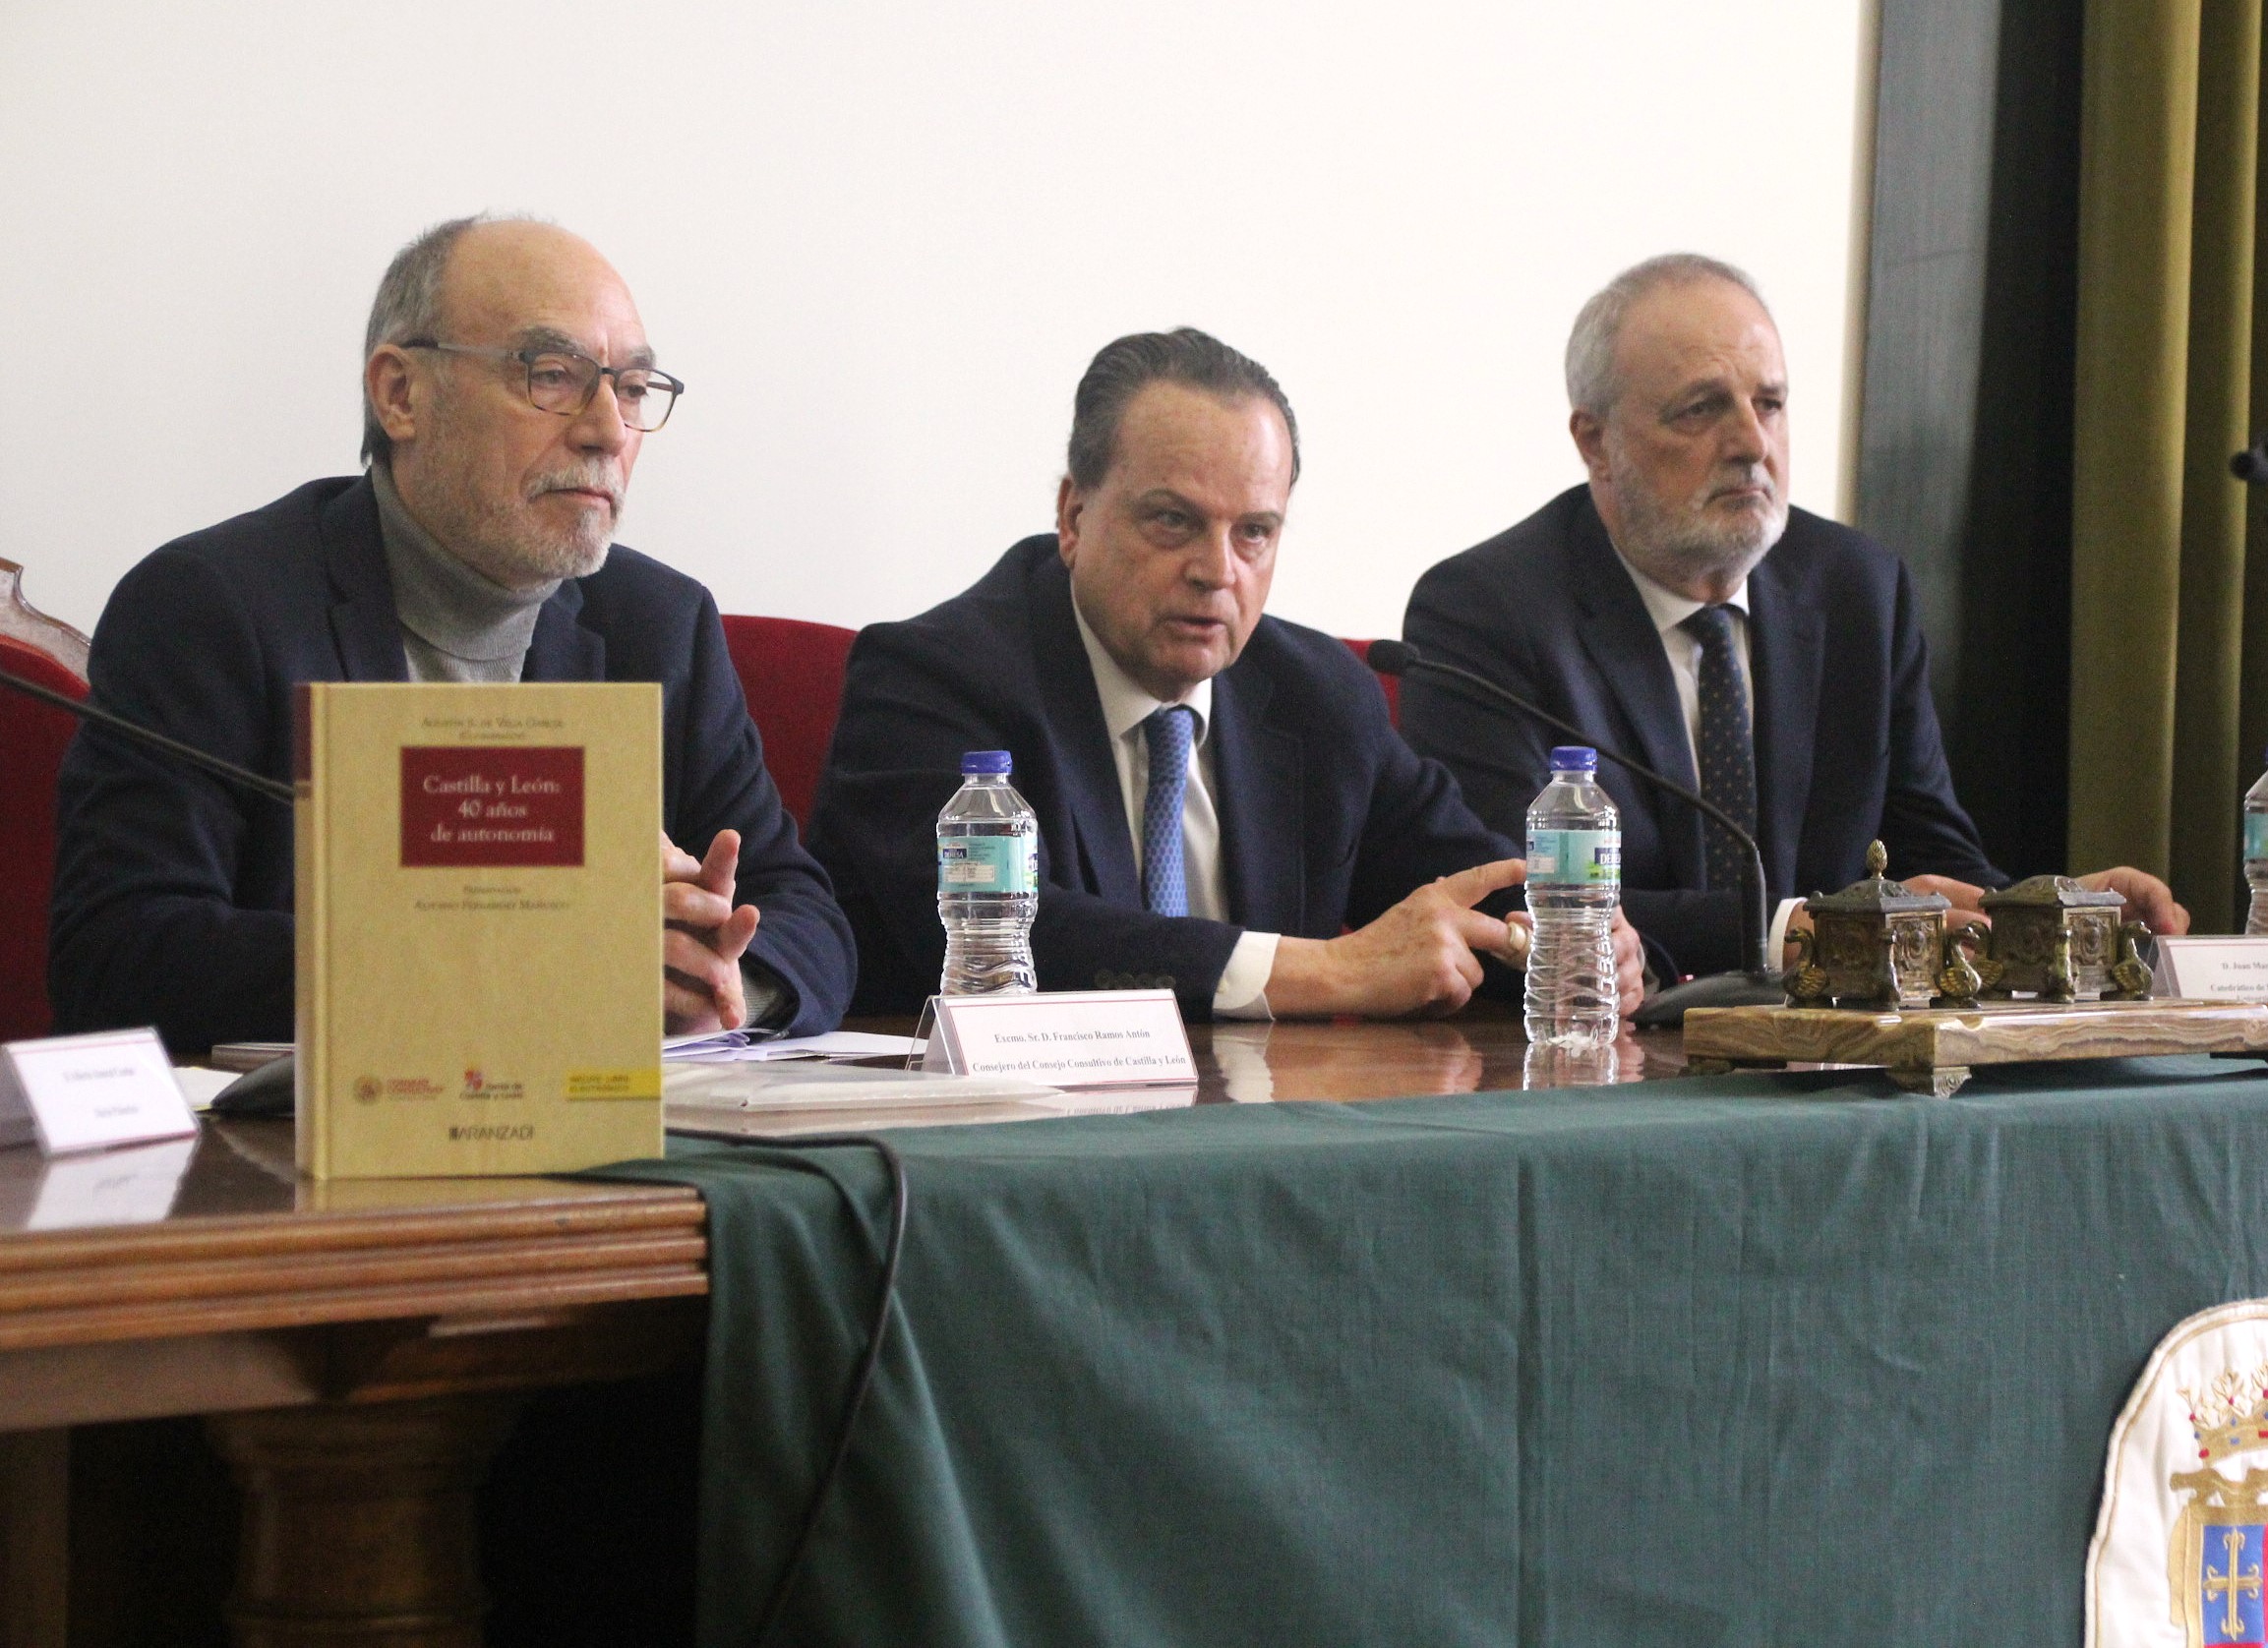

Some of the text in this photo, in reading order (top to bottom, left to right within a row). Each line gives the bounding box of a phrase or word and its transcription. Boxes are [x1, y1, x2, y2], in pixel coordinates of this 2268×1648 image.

[423, 774, 491, 794] Castilla
[495, 781, 506, 796] y
[457, 798, 528, 818] 40 años
[430, 822, 555, 843] de autonomía
[993, 1029, 1151, 1043] Excmo. Sr. D. Francisco Ramos Antón
[972, 1061, 1016, 1073] Consejero
[1017, 1060, 1031, 1071] del
[1032, 1058, 1066, 1071] Consejo
[1067, 1056, 1112, 1069] Consultivo
[1113, 1056, 1123, 1067] de
[1125, 1055, 1158, 1066] Castilla
[1164, 1054, 1186, 1065] León
[457, 1124, 534, 1141] ARANZADI
